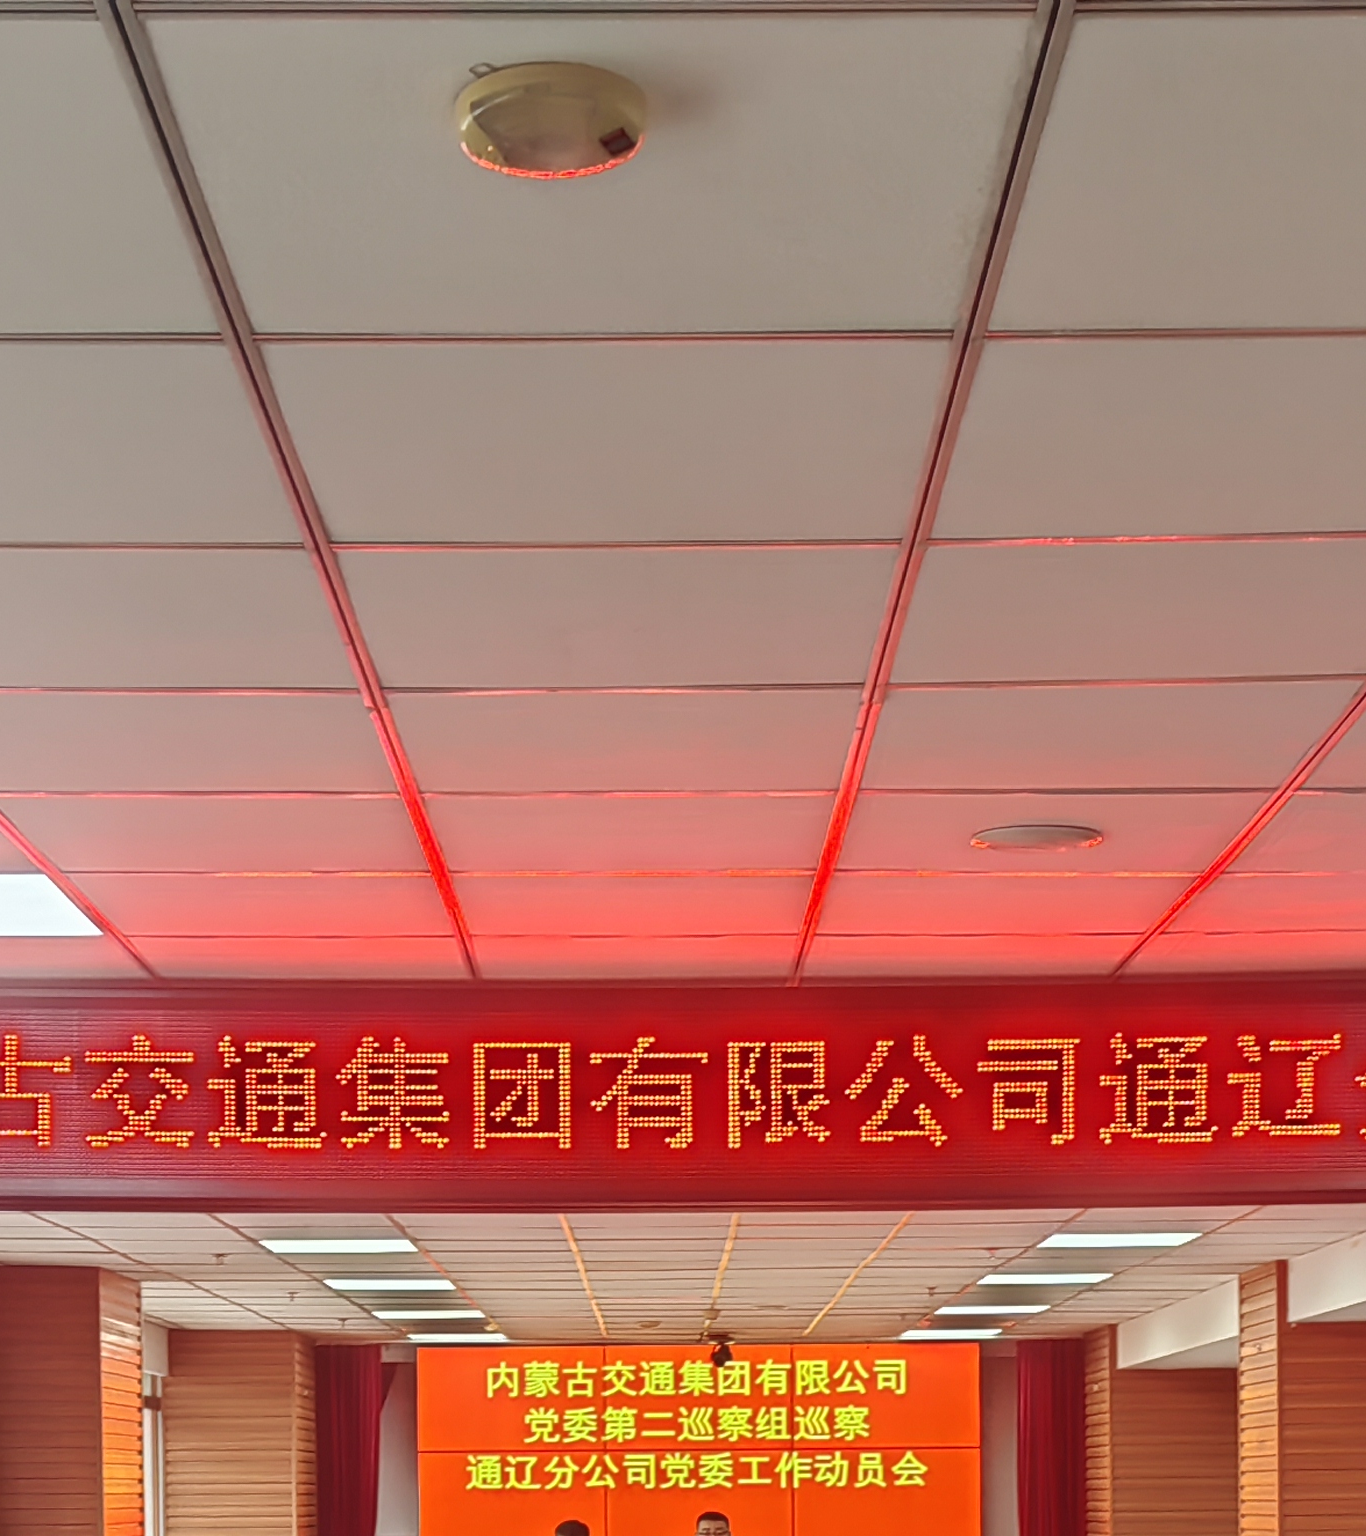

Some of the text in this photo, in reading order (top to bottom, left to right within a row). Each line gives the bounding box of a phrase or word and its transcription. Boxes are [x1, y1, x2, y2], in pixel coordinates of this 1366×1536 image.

[486, 1358, 908, 1399] 内蒙古交通集团有限公司
[523, 1404, 870, 1444] 党委第二巡察组巡察
[465, 1450, 929, 1491] 通辽分公司党委工作动员会
